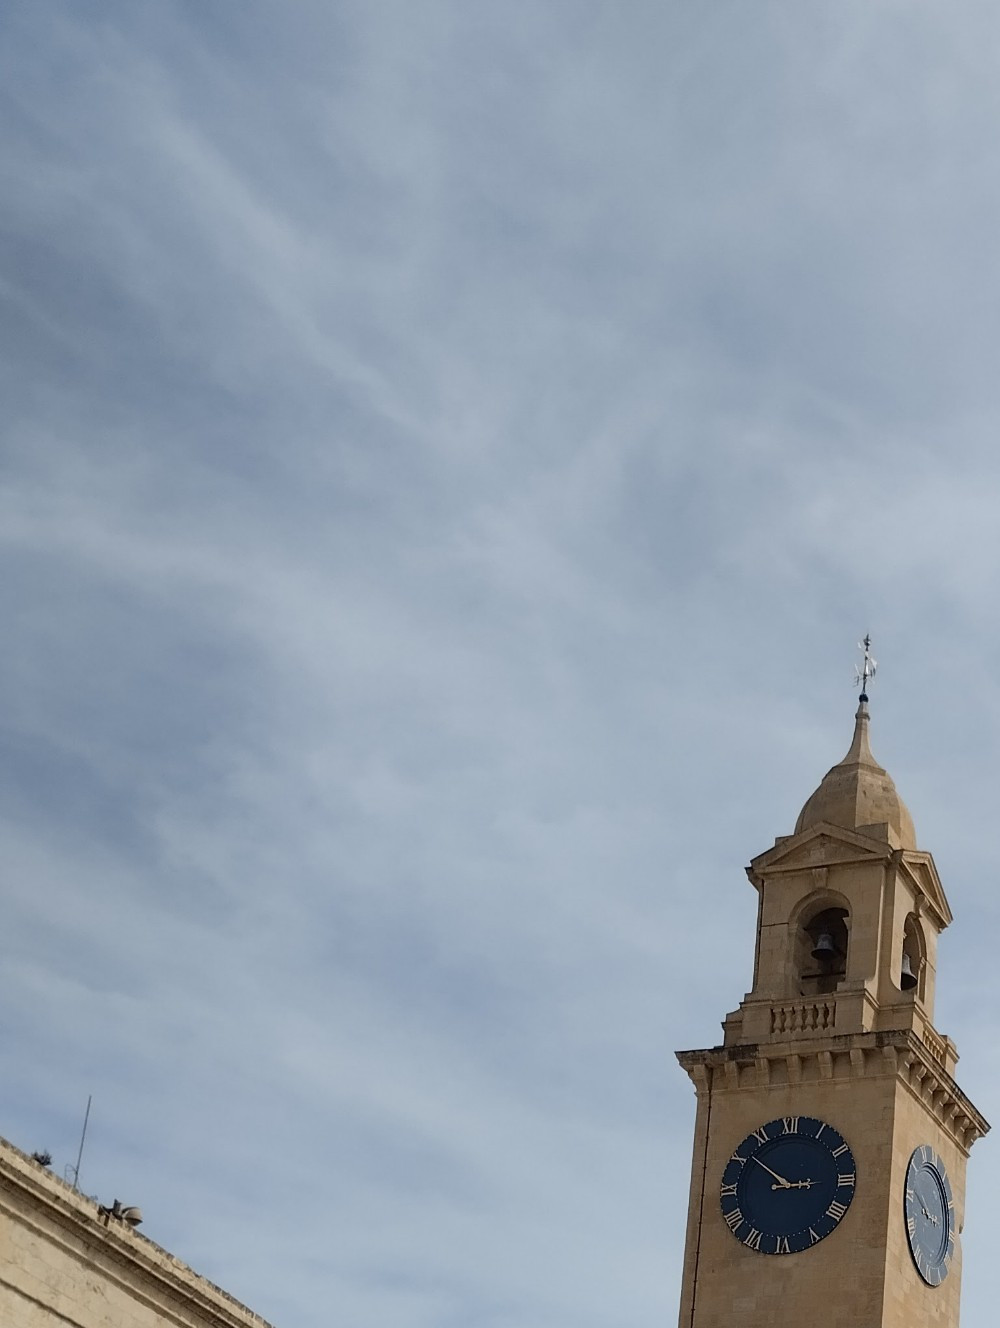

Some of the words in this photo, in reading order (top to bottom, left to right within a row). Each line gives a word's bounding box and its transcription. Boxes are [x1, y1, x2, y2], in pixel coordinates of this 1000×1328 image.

[782, 1117, 799, 1134] XII
[815, 1123, 827, 1139] I
[752, 1127, 770, 1147] XI
[832, 1143, 849, 1158] II
[731, 1152, 747, 1168] X
[838, 1174, 855, 1187] III
[721, 1182, 738, 1197] IX
[826, 1200, 848, 1222] IIII
[724, 1208, 744, 1233] VIII
[743, 1228, 763, 1250] VII
[809, 1226, 821, 1243] V
[774, 1236, 790, 1254] VI
